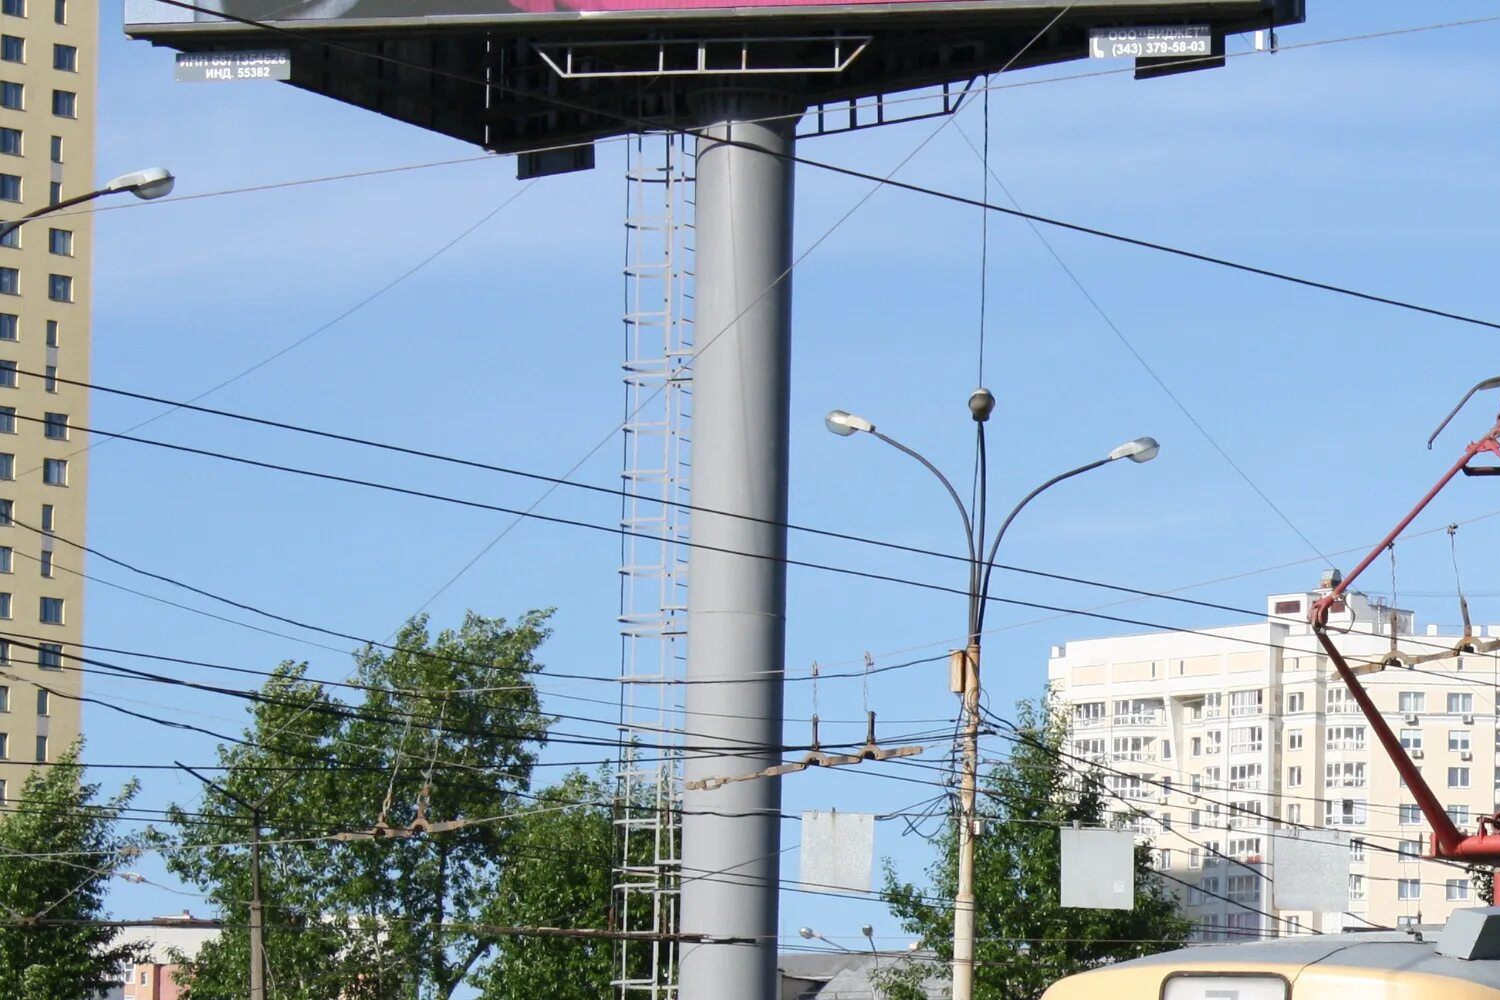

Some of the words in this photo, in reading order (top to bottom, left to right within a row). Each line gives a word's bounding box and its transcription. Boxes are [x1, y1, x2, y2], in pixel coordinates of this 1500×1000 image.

[1111, 43, 1142, 56] (343)
[1146, 41, 1206, 54] 379-58-03
[205, 69, 234, 80] ИНД.
[237, 67, 270, 79] 55382
